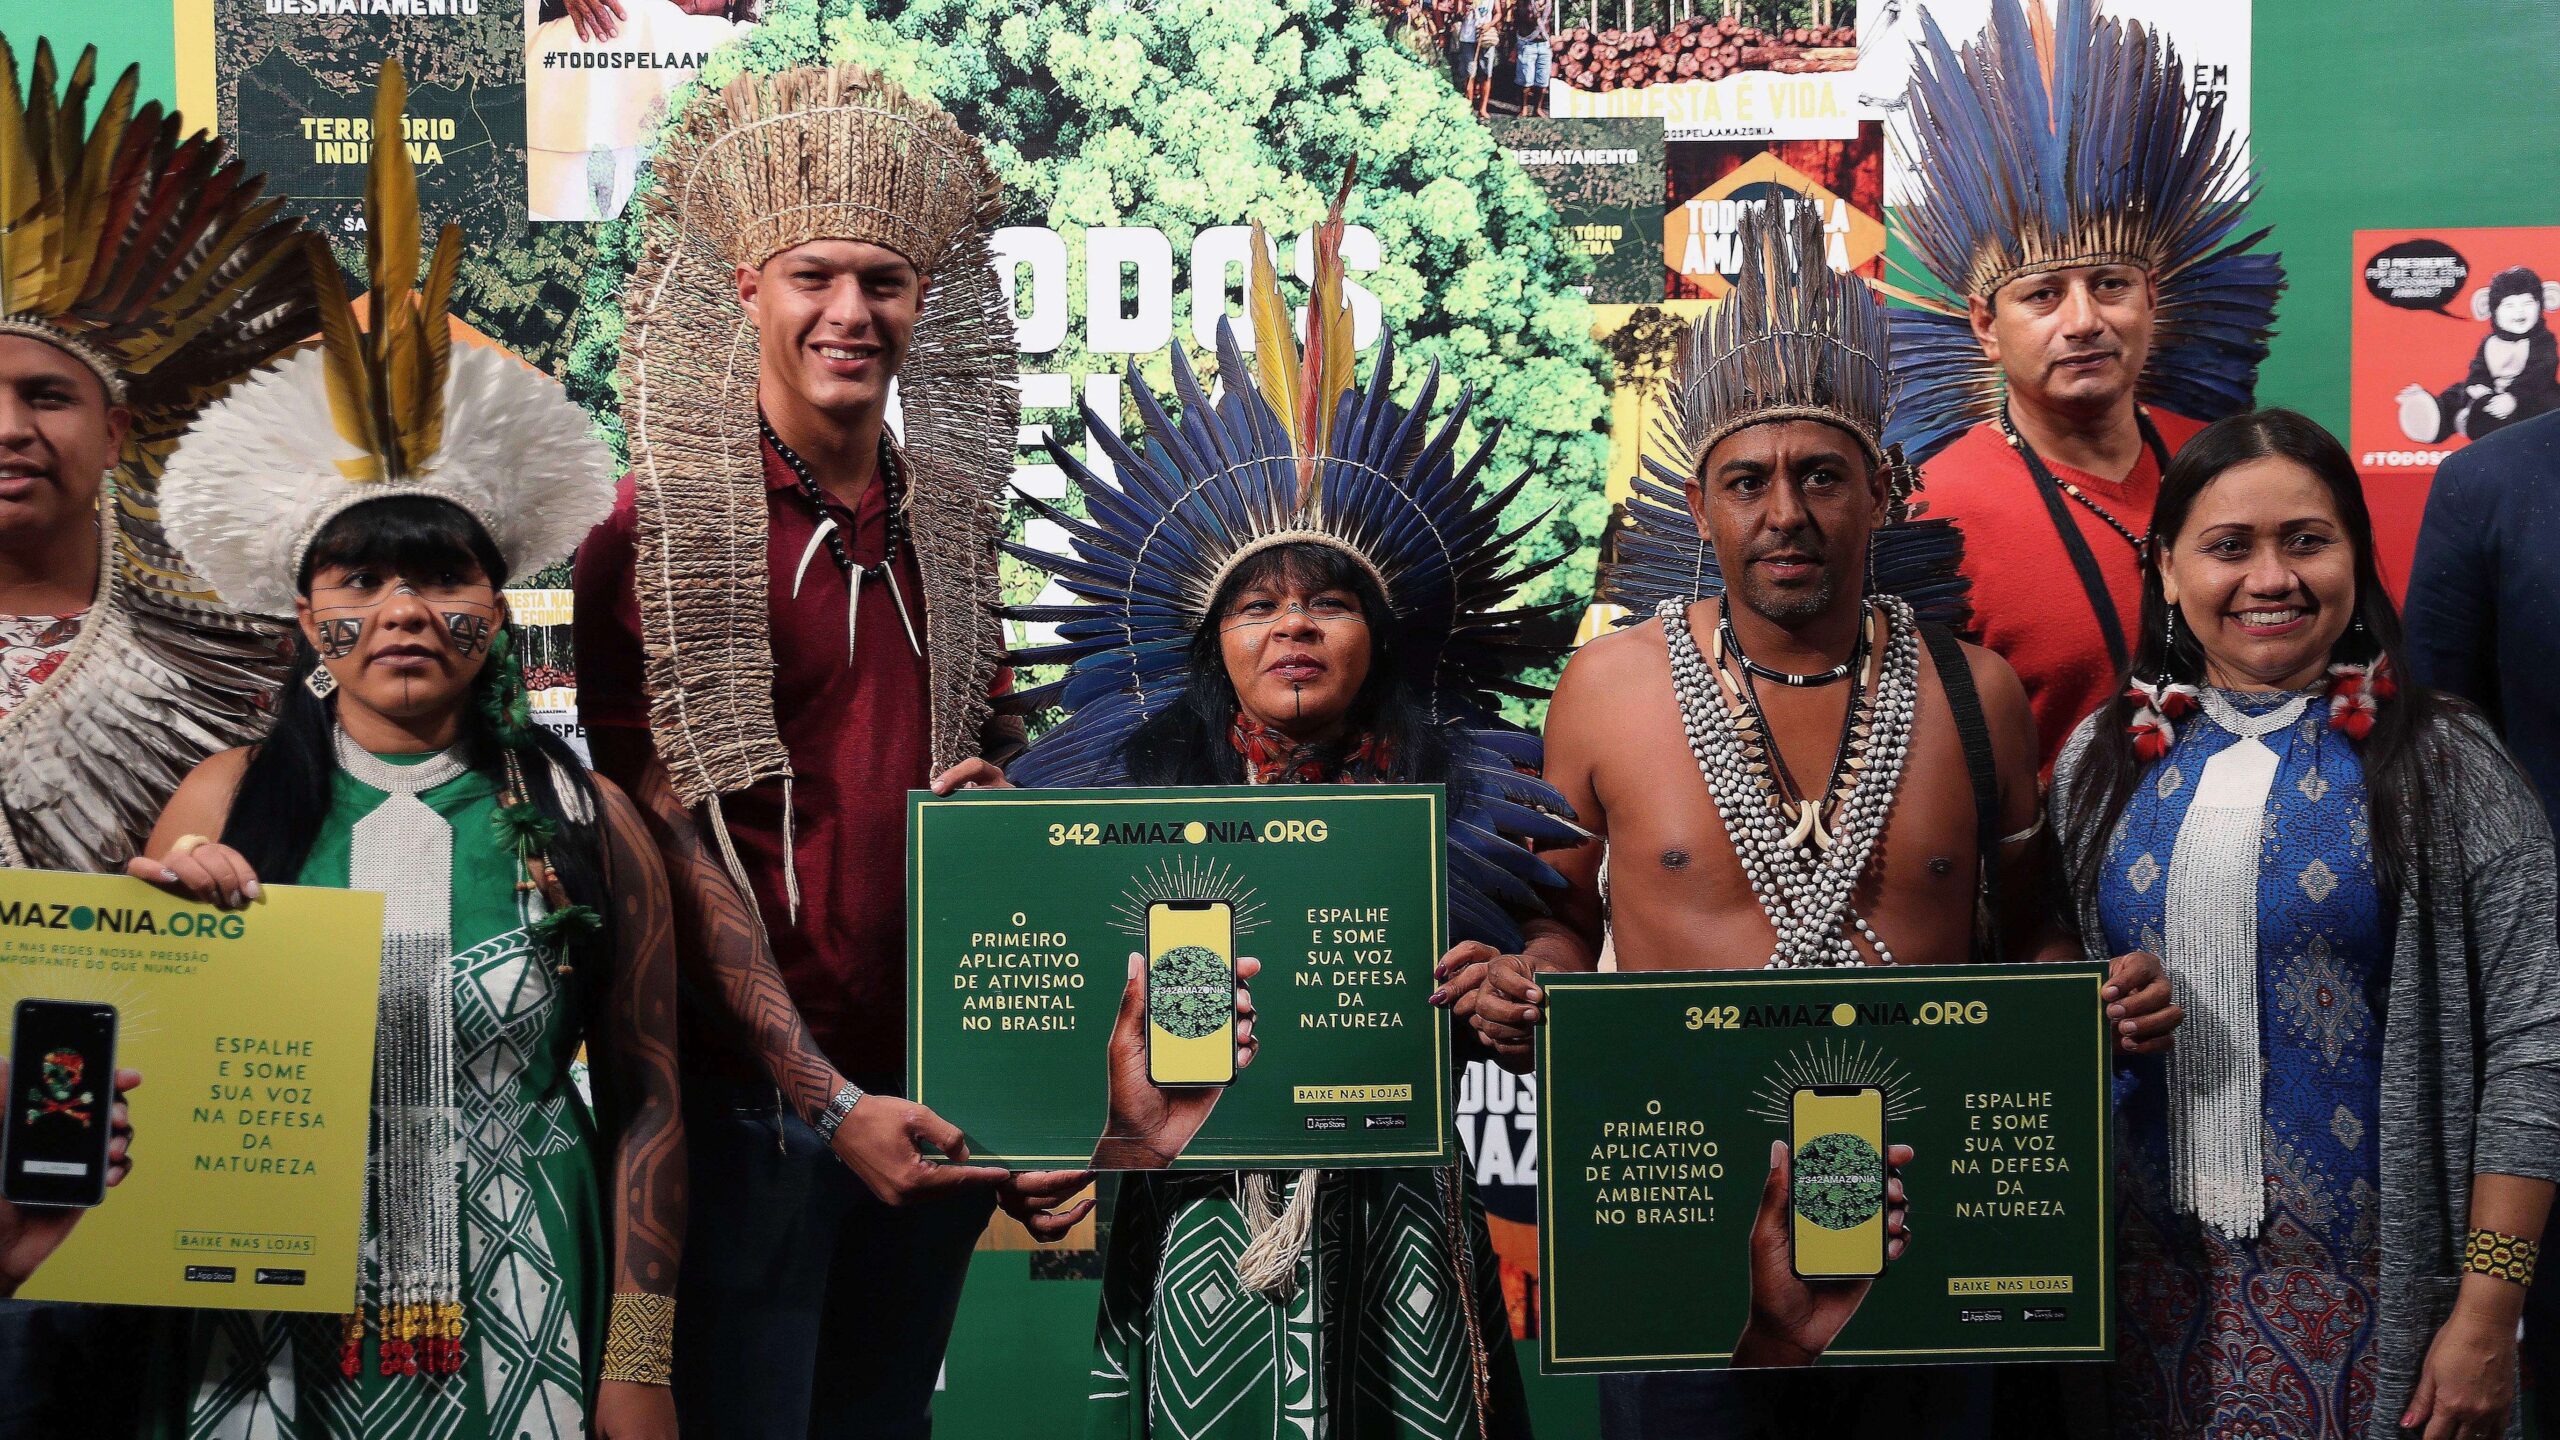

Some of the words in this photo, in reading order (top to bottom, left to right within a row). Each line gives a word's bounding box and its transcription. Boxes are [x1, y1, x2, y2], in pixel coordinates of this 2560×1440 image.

[1768, 82, 1849, 120] VIDA.
[300, 114, 457, 141] TERRÓRIO
[315, 138, 444, 165] INDÍNA
[1048, 819, 1329, 847] 342AMAZONIA.ORG
[1012, 911, 1027, 927] O
[1307, 907, 1390, 924] ESPALHE
[971, 932, 1067, 948] PRIMEIRO
[1312, 929, 1323, 944] E
[1332, 928, 1387, 944] SOME
[959, 952, 1080, 969] APLICATIVO
[1307, 950, 1345, 966] SUA
[1353, 949, 1394, 965] VOZ
[954, 974, 979, 990] DE
[988, 973, 1085, 989] ATIVISMO
[1295, 971, 1324, 987] NA
[1332, 970, 1407, 986] DEFESA
[963, 990, 1076, 1010] AMBIENTAL
[1337, 992, 1365, 1008] DA
[962, 1015, 992, 1031] NO
[1001, 1015, 1076, 1031] BRASIL!
[1300, 1012, 1404, 1029] NATUREZA
[1685, 1000, 1990, 1031] 342AMAZONIA.ORG
[215, 1036, 314, 1057] ESPALHE
[219, 1060, 230, 1077] E
[244, 1062, 307, 1081] SOME
[210, 1084, 252, 1101] SUA
[267, 1087, 313, 1105] VOZ
[1298, 1090, 1334, 1100] BAIXE
[1340, 1089, 1366, 1099] NAS
[1371, 1088, 1408, 1099] LOJAS
[1964, 1091, 2053, 1109] ESPALHE
[1646, 1099, 1662, 1116] O
[192, 1107, 225, 1124] NA
[238, 1109, 326, 1129] DEFESA
[1970, 1115, 1982, 1131] E
[1992, 1113, 2049, 1131] SOME
[1603, 1120, 1705, 1138] PRIMEIRO
[242, 1133, 273, 1150] DA
[1590, 1141, 1719, 1160] APLICATIVO
[1964, 1136, 2004, 1153] SUA
[2013, 1135, 2056, 1151] VOZ
[194, 1154, 317, 1175] NATUREZA
[1585, 1165, 1611, 1182] DE
[1621, 1163, 1724, 1181] ATIVISMO
[1951, 1159, 1981, 1175] NA
[1991, 1157, 2070, 1174] DEFESA
[1595, 1185, 1715, 1204] AMBIENTAL
[1996, 1179, 2025, 1196] DA
[1595, 1209, 1626, 1225] NO
[1636, 1207, 1715, 1224] BRASIL!
[1956, 1200, 2066, 1218] NATUREZA
[230, 1238, 260, 1249] NAS
[267, 1240, 310, 1251] LOJAS
[1953, 1281, 1991, 1292] BAIXE
[1997, 1280, 2023, 1291] NAS
[2029, 1279, 2069, 1290] LOJAS
